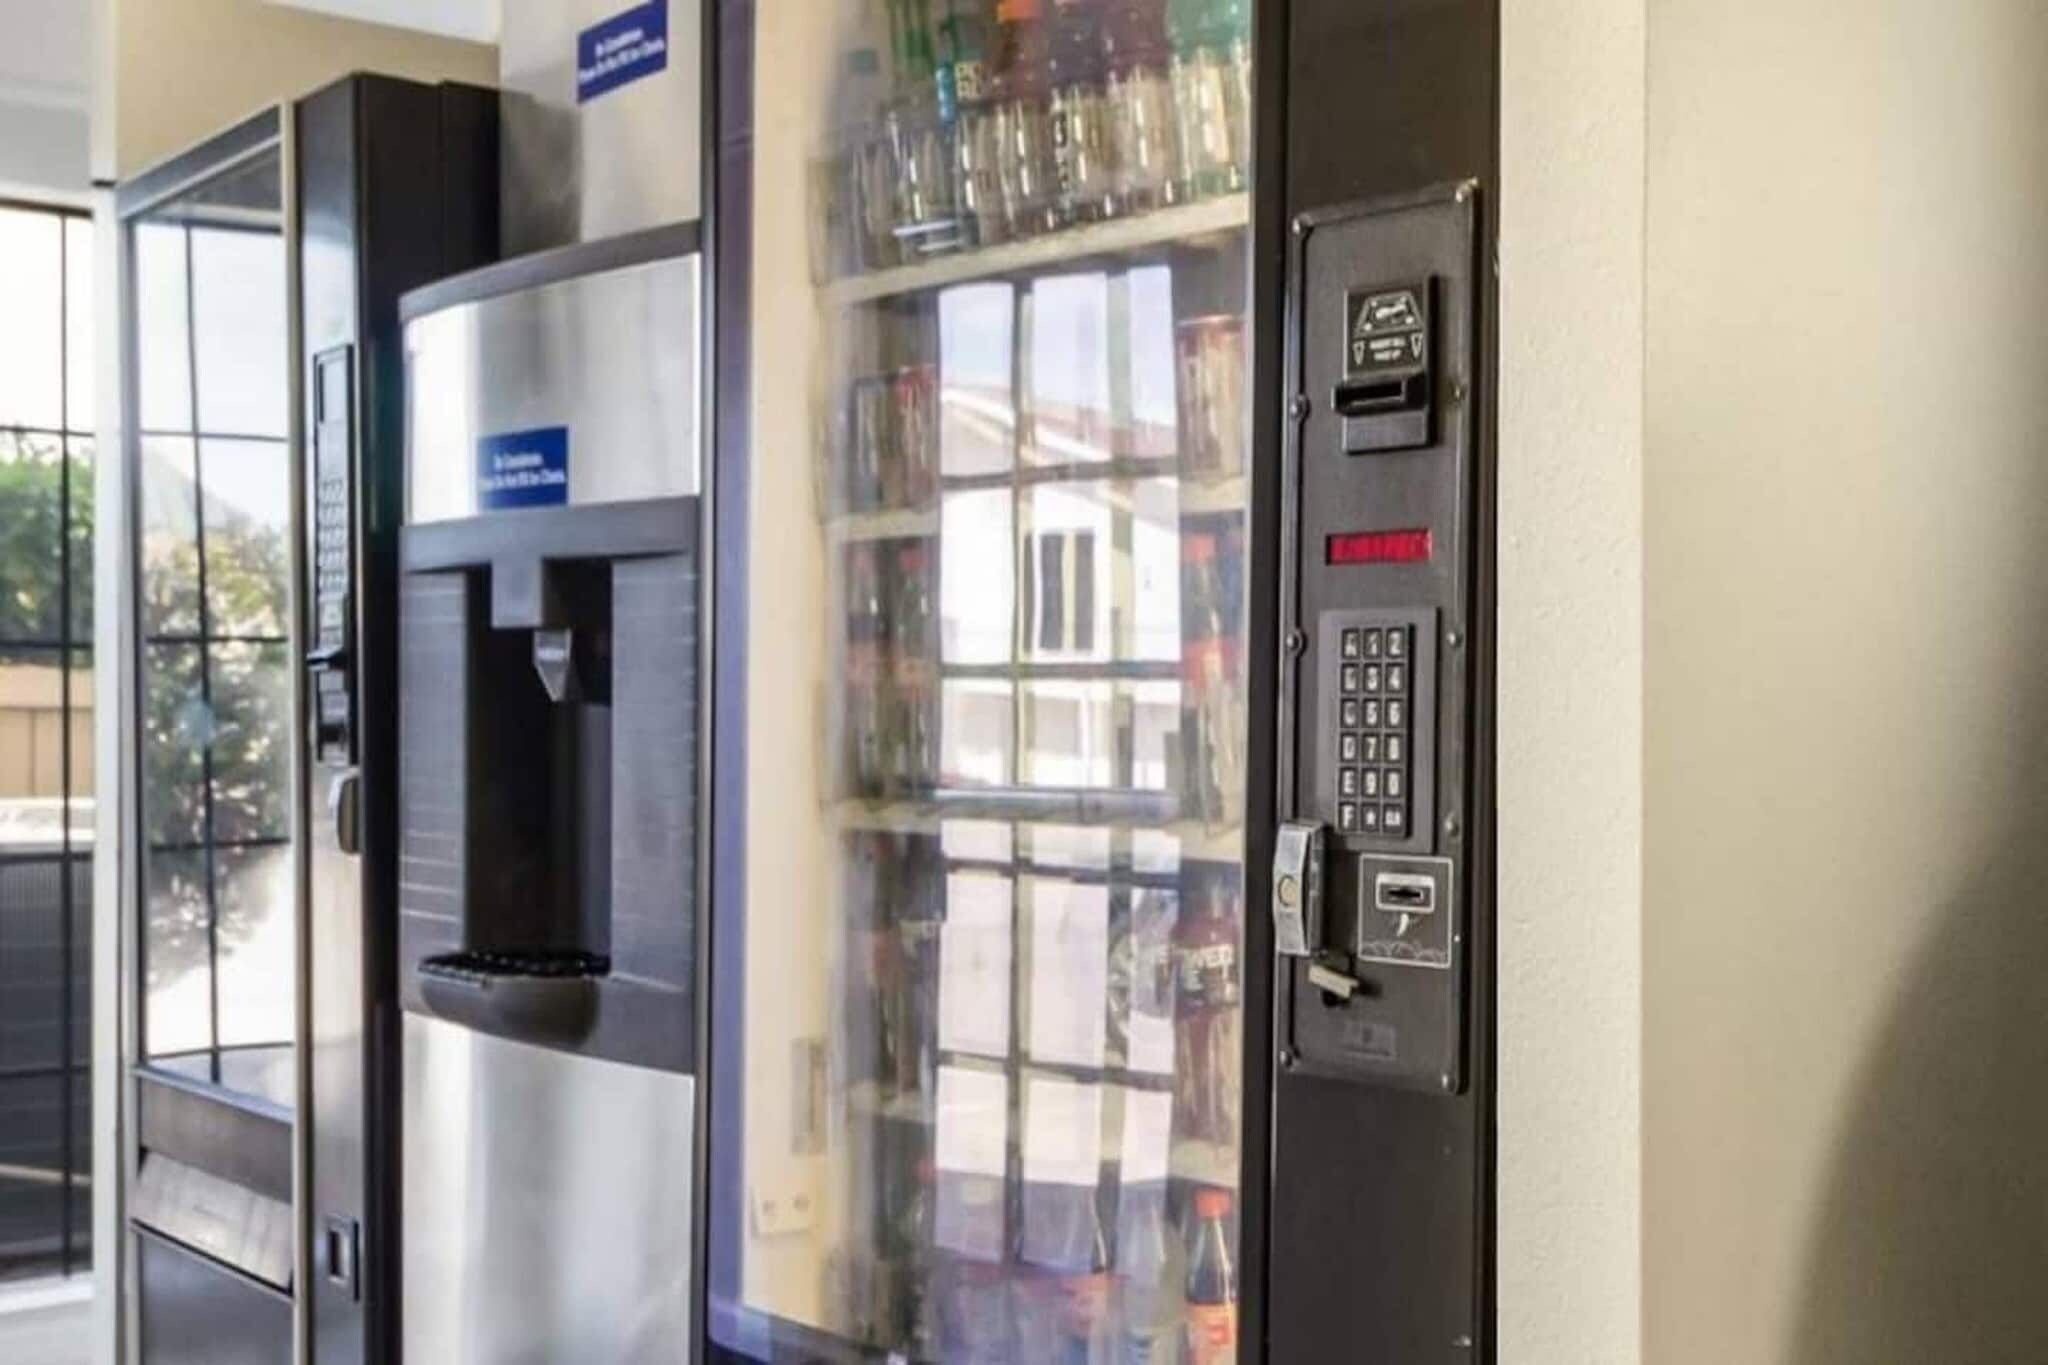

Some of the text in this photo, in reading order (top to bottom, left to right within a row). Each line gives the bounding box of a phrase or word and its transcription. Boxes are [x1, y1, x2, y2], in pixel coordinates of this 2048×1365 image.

[1366, 634, 1378, 655] 1
[1390, 633, 1401, 654] 2
[1389, 668, 1401, 688] 4
[1389, 703, 1400, 724] 6
[1367, 738, 1377, 759] 7
[1343, 772, 1354, 793] E
[1366, 773, 1377, 794] 9
[1343, 806, 1353, 827] F
